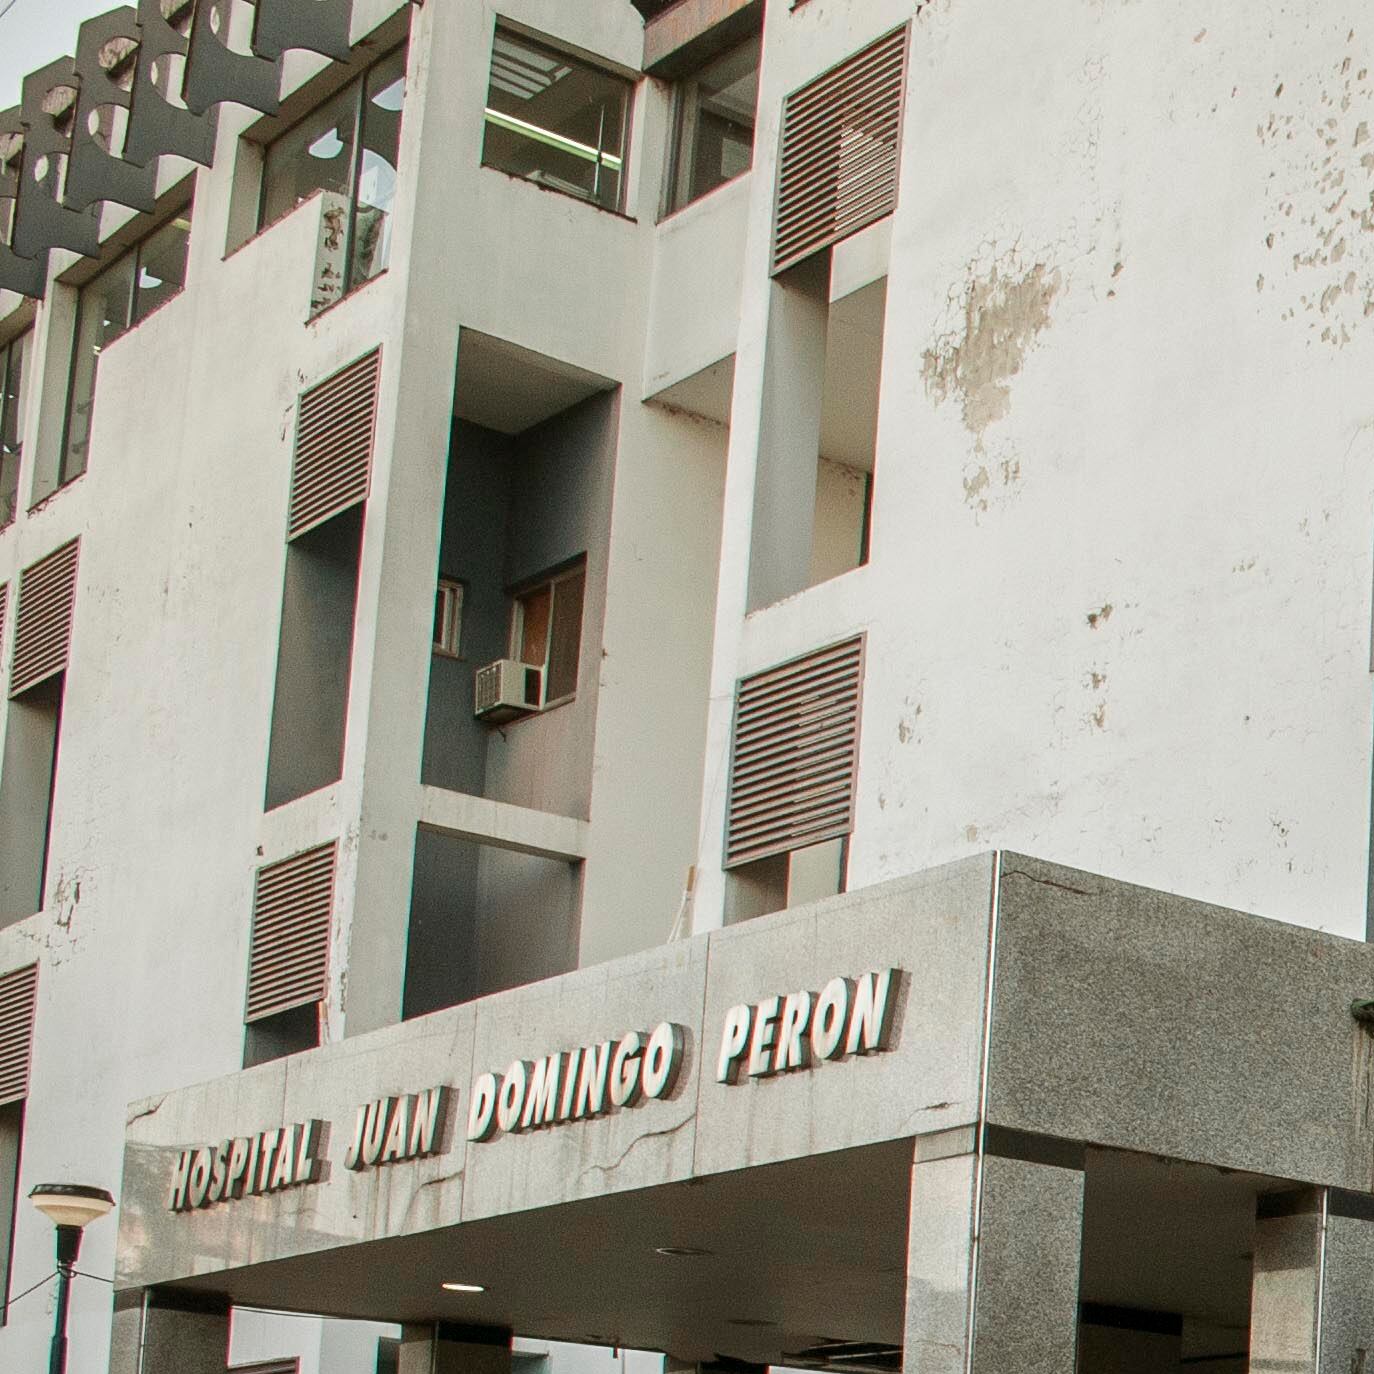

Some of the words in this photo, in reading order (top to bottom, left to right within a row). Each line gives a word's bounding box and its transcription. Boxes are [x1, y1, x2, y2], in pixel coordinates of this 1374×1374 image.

[169, 1119, 316, 1212] HOSPITAL
[345, 1085, 443, 1170] JUAN
[468, 1022, 676, 1142] DOMINGO
[717, 968, 895, 1084] PERON
